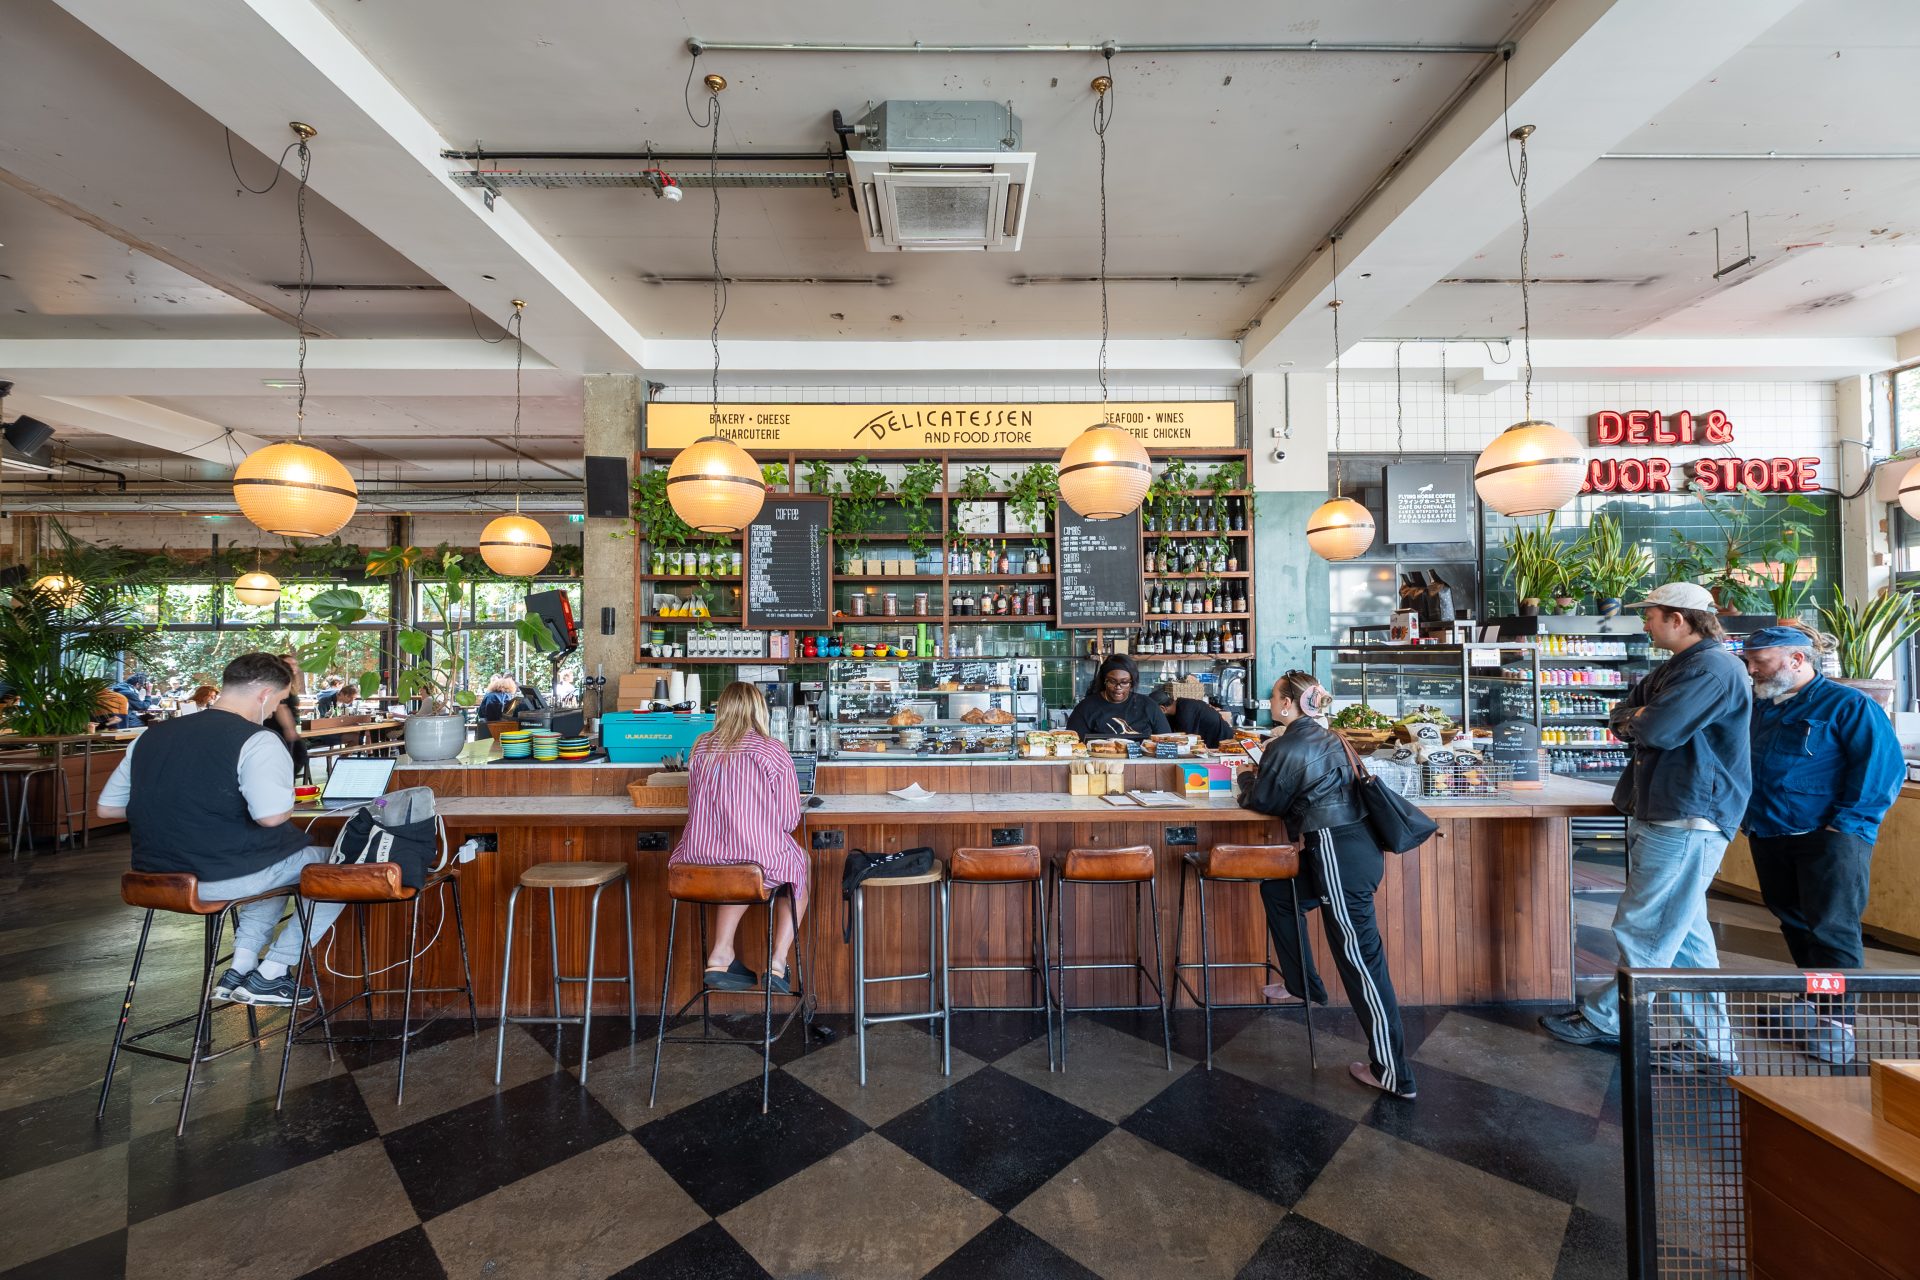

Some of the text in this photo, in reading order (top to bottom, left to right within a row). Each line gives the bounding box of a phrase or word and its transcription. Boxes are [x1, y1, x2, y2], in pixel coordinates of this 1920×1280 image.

[709, 413, 791, 425] BAKERY CHEESE
[1105, 412, 1184, 424] SEAFOOD WINES
[853, 410, 1032, 440] DELICATESSEN
[1598, 409, 1734, 444] DELI &
[719, 428, 780, 440] CHARCUTERIE
[924, 431, 1032, 443] AND FOOD STORE
[1153, 427, 1191, 439] CHICKEN
[1584, 457, 1821, 492] UOR STORE
[775, 508, 799, 521] COFFEE
